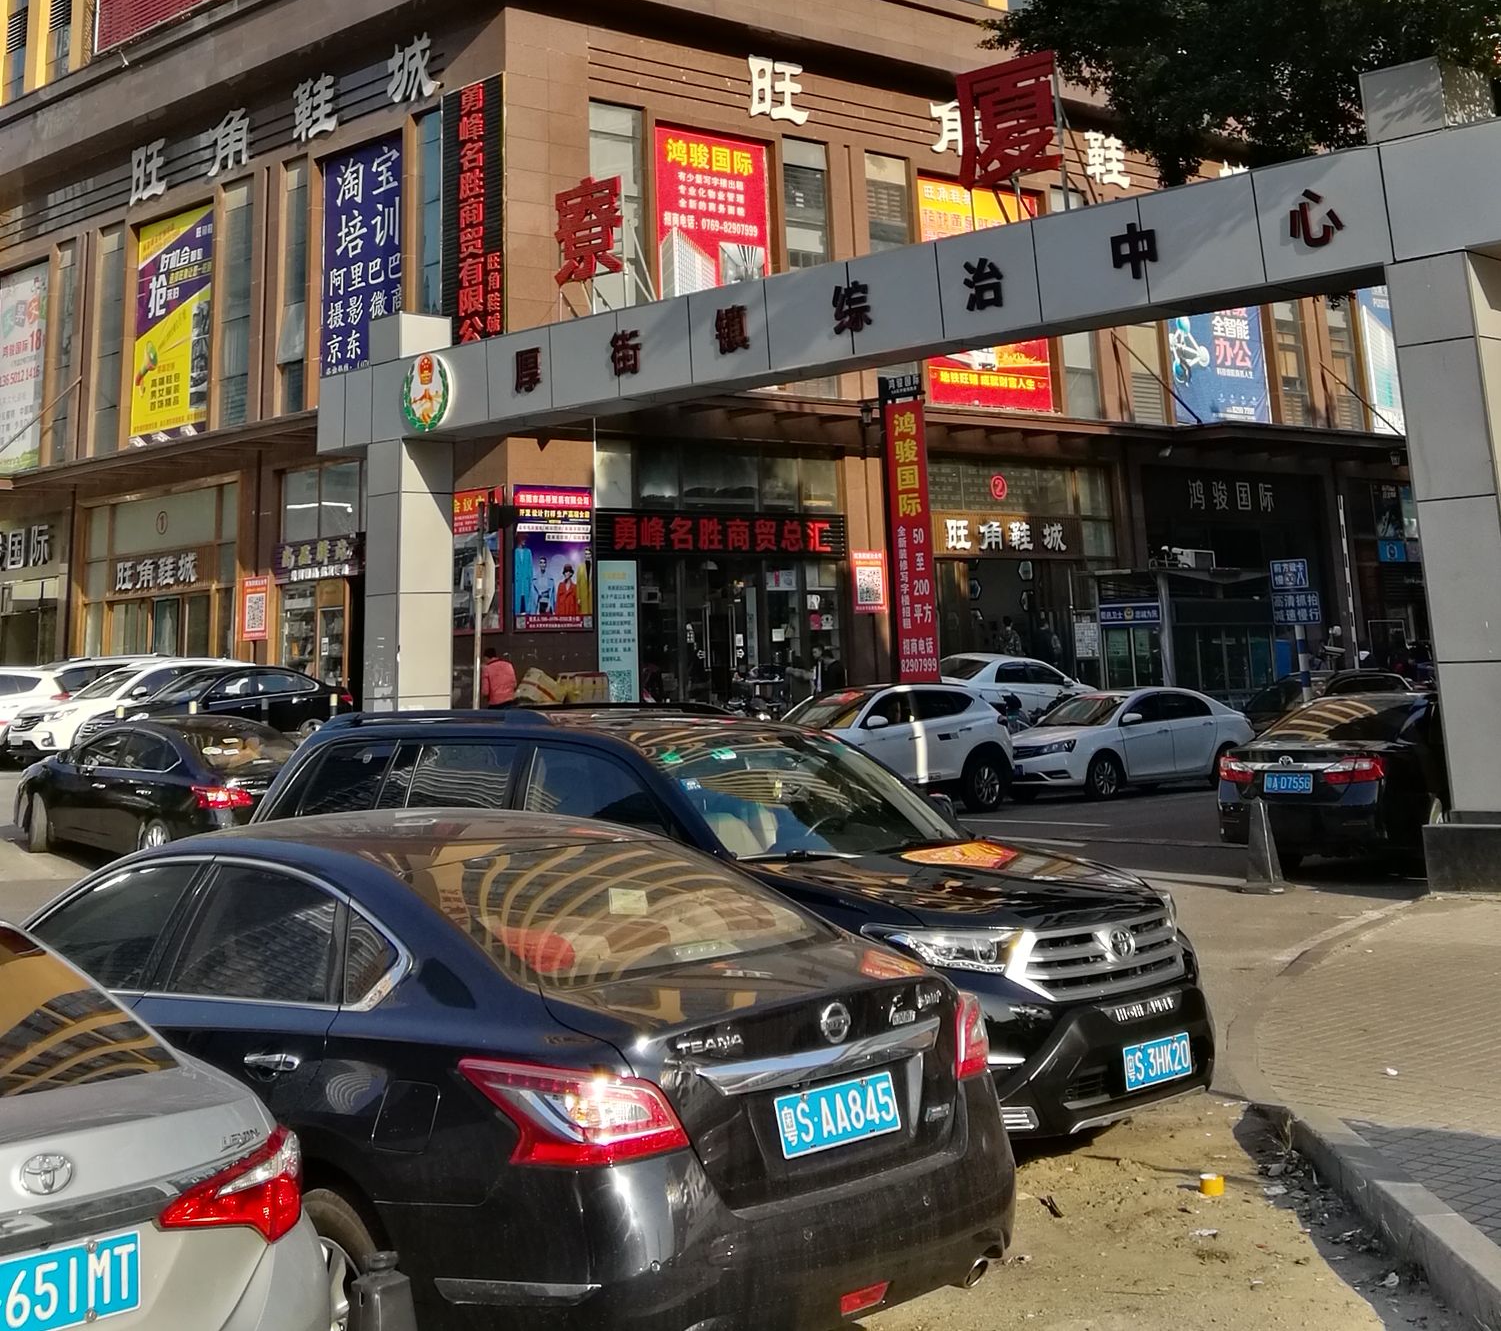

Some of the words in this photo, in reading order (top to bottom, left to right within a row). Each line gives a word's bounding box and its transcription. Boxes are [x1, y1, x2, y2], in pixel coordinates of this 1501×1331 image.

[129, 32, 440, 207] 旺角鞋城
[667, 138, 753, 176] 鸿骏国际
[336, 146, 400, 207] 淘宝
[336, 196, 400, 258] 培训
[329, 253, 401, 296] 阿里巴巴
[514, 188, 1344, 397] 厚街镇综治中心
[1212, 315, 1250, 341] 全智能
[327, 330, 361, 364] 京东
[1215, 337, 1252, 369] 办公
[894, 411, 922, 517] 鸿骏国际
[1188, 479, 1275, 512] 鸿骏国际
[0, 524, 50, 570] 国际
[614, 517, 833, 551] 勇峰名胜商贸总汇
[912, 527, 925, 544] 50
[945, 519, 1067, 551] 旺角鞋城
[115, 552, 199, 591] 旺角鞋城
[915, 552, 926, 571] 至
[913, 579, 930, 596] 200
[914, 603, 932, 623] 平方
[903, 637, 934, 655] 招商电话
[901, 657, 938, 673] 82907999
[677, 1033, 744, 1054] TEANA
